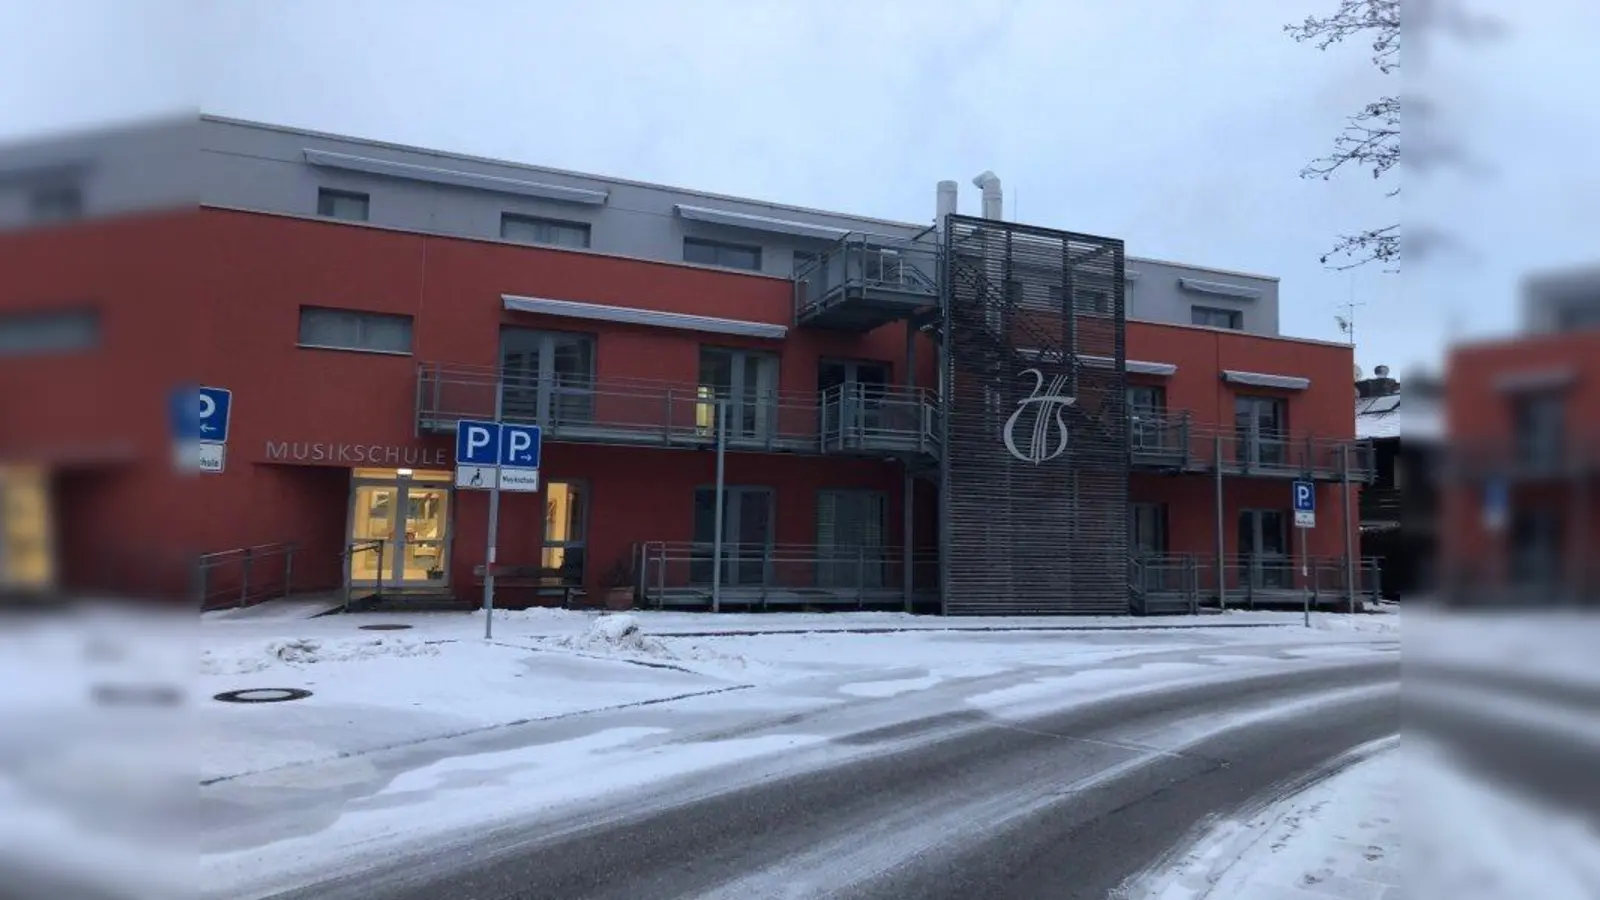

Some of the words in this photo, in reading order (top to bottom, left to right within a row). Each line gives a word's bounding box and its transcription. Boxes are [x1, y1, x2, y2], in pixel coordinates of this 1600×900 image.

[266, 441, 447, 465] MUSIKSCHULE
[467, 427, 490, 458] P
[509, 430, 531, 461] P
[1298, 485, 1309, 507] P
